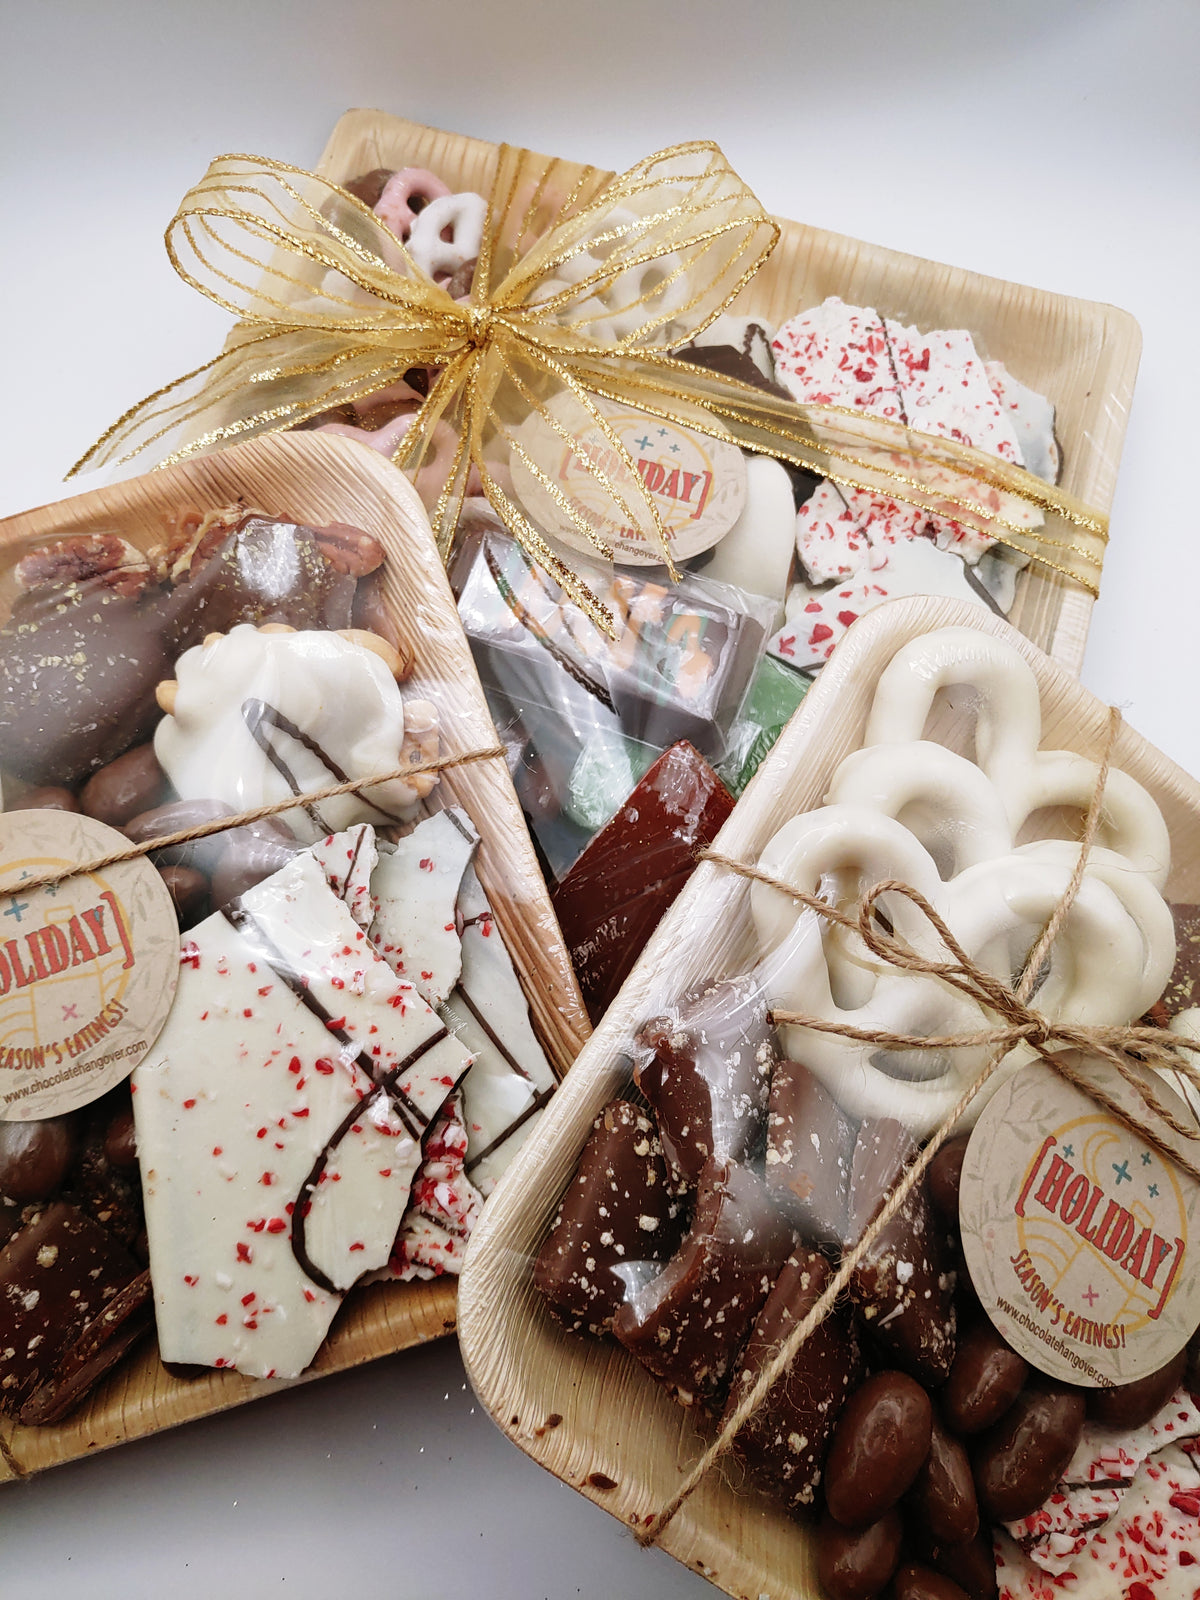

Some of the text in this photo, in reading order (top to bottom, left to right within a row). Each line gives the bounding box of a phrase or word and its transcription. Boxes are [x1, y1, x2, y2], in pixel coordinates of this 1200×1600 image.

[64, 997, 128, 1059] EATINGS!
[2, 1039, 148, 1104] www.chocolatehangover.com
[1034, 1153, 1173, 1290] HOLIDAY
[1010, 1248, 1126, 1350] SEASON'S EATINGS!
